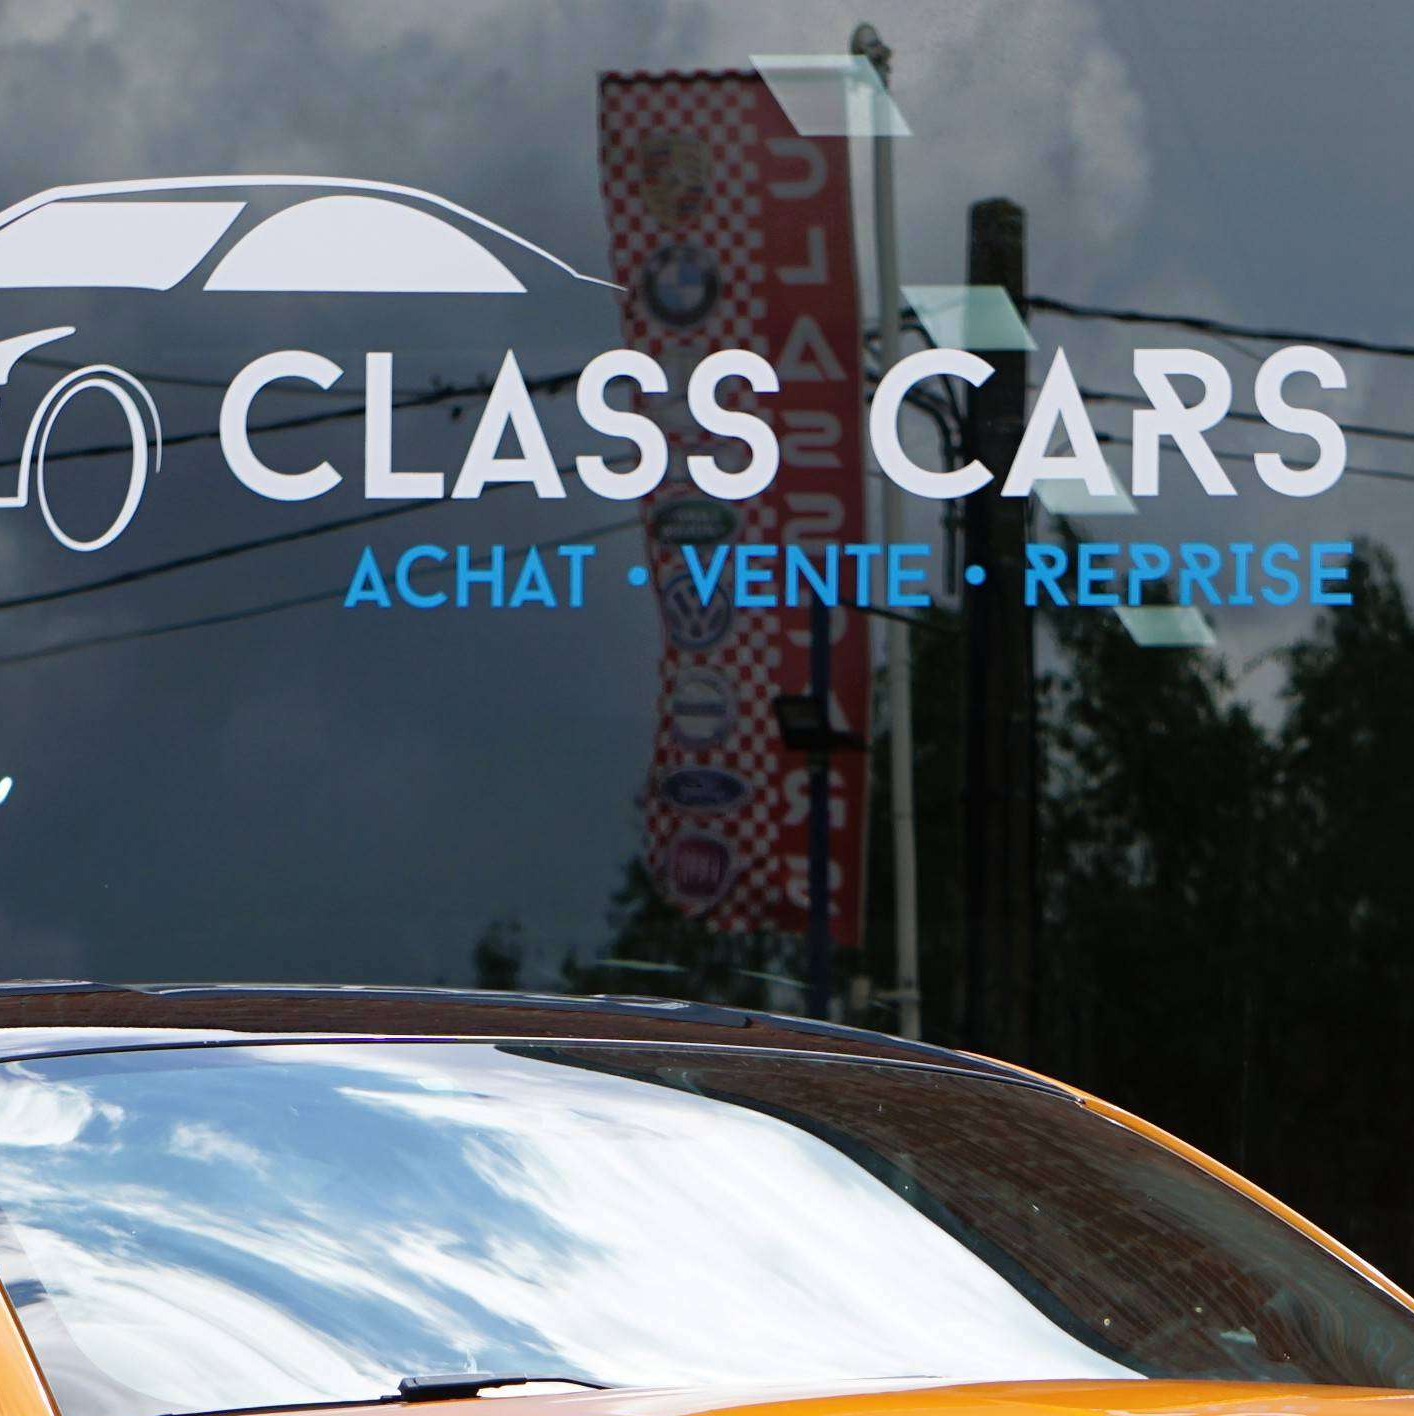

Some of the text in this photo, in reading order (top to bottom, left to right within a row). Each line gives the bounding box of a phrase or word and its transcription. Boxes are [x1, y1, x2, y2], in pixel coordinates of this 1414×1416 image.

[220, 346, 1347, 500] CLASS CARS
[343, 540, 1355, 608] ACHAT VENTE REPRISE
